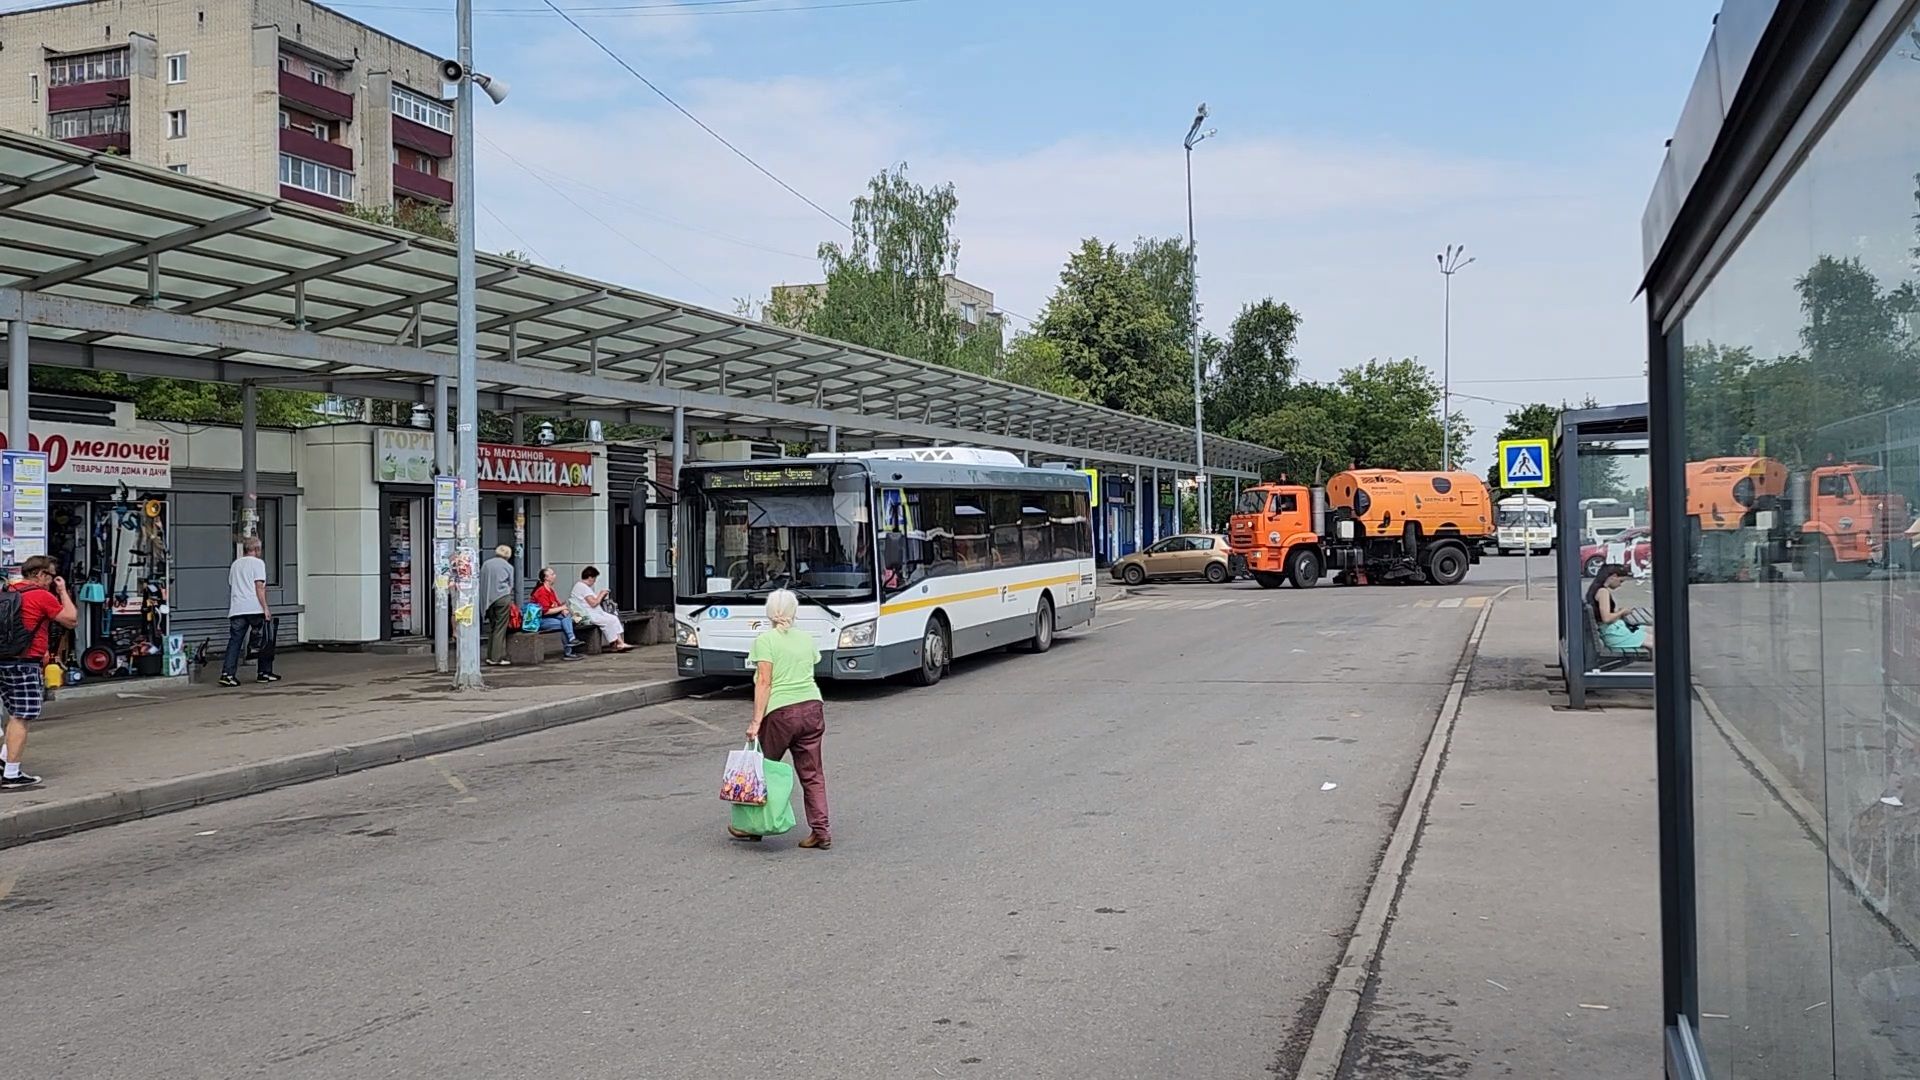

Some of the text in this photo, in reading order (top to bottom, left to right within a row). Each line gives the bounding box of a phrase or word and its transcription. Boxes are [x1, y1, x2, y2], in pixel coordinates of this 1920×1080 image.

[70, 438, 169, 461] мелочей
[383, 431, 434, 450] ТОРТ
[477, 447, 544, 460] ТЬ МАГАЗИНОВ
[72, 464, 167, 476] ТОВАРЫ ДЛЯ ДОМА И ДАЧИ
[558, 462, 593, 487] ДОМ
